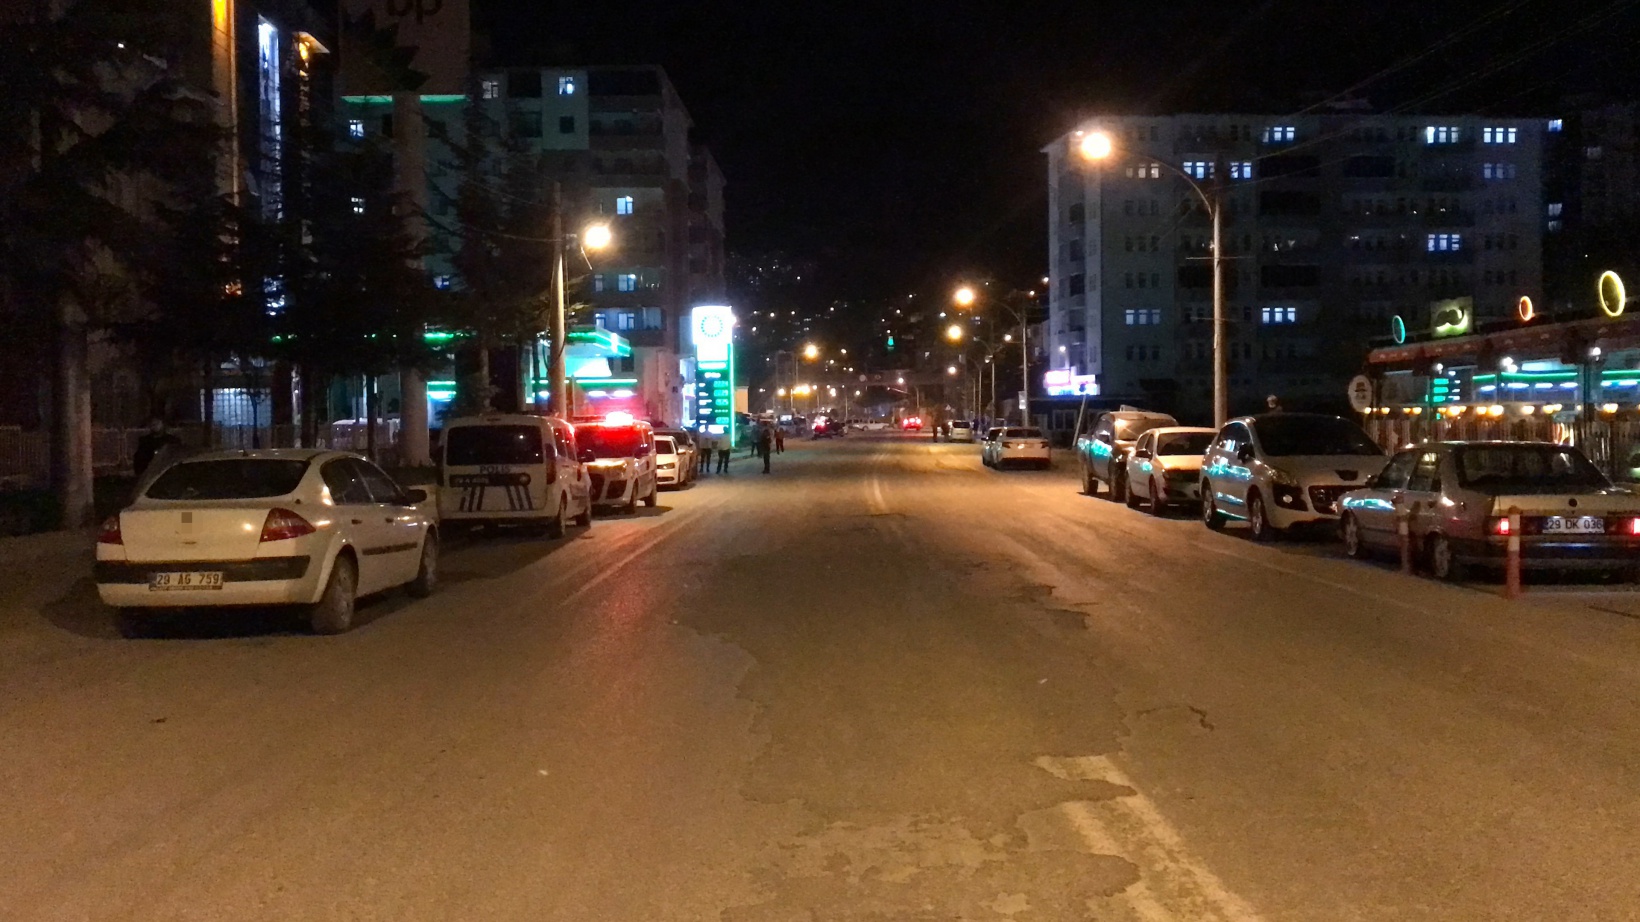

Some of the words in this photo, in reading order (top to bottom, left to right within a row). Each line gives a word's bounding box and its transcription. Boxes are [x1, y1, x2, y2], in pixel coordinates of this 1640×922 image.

[1549, 520, 1561, 529] 29
[1565, 520, 1580, 529] DK
[1583, 520, 1603, 529] 036
[157, 574, 171, 585] 29
[178, 574, 191, 585] AG
[199, 573, 220, 584] 759
